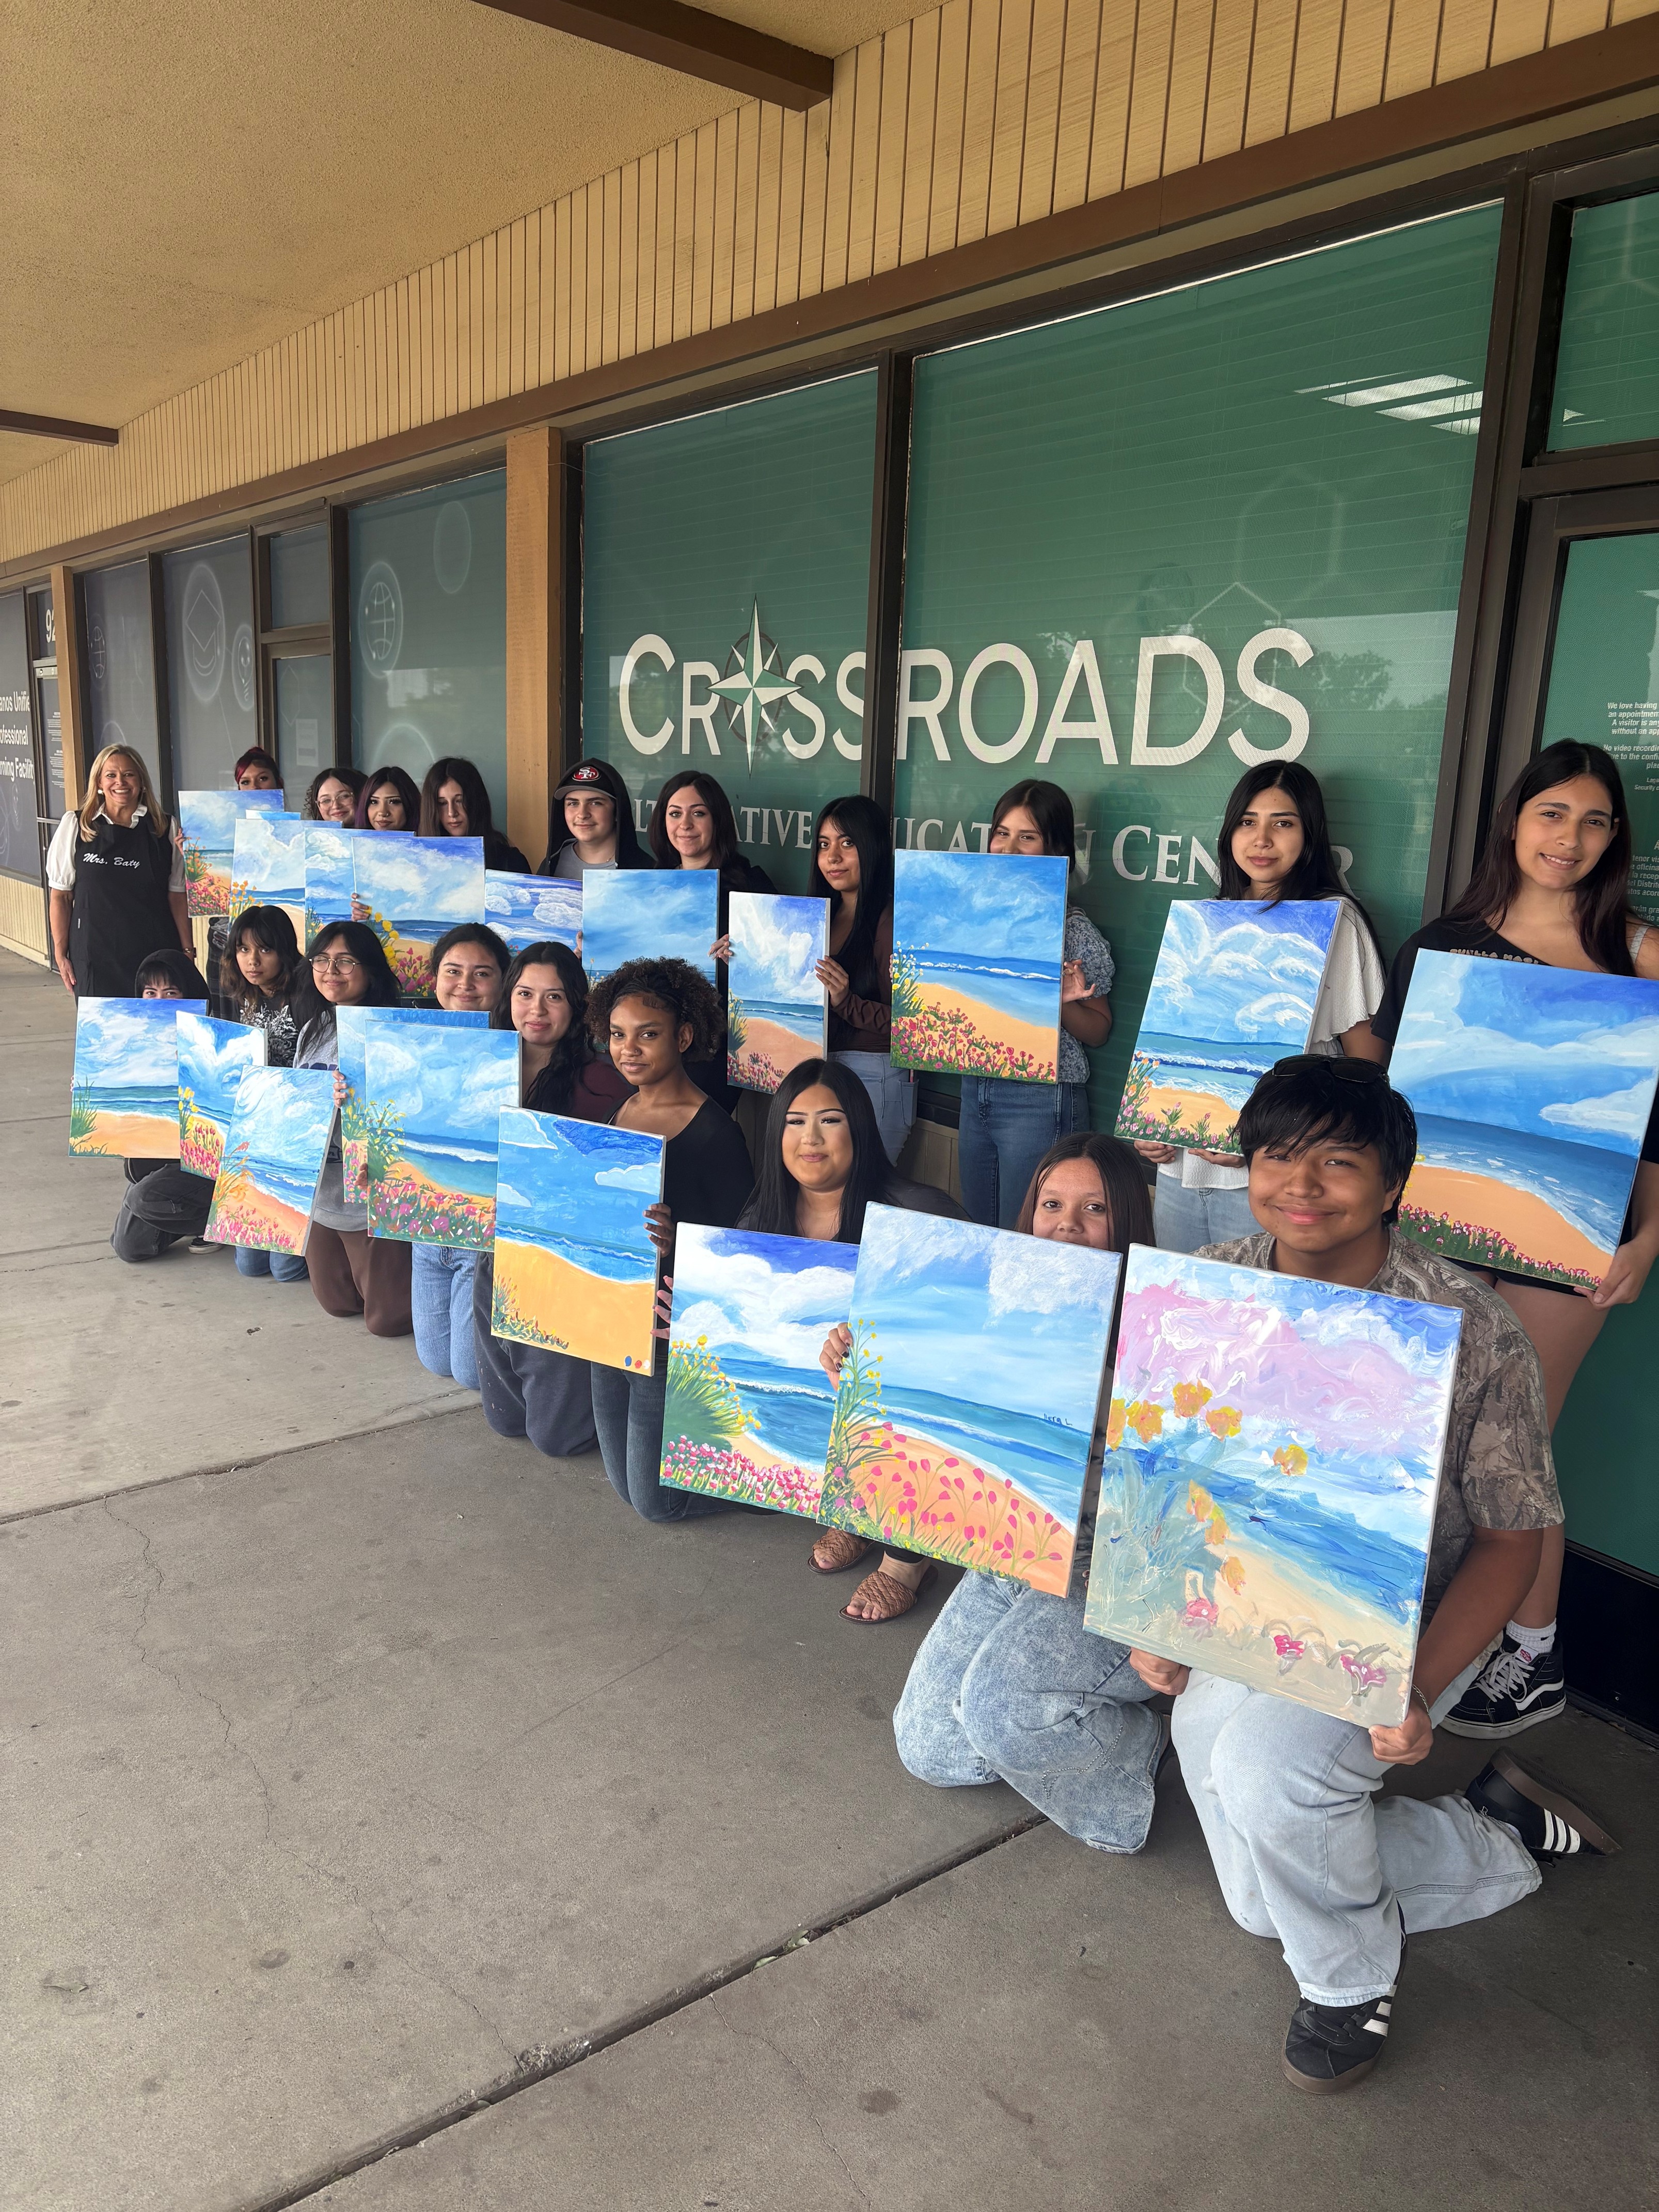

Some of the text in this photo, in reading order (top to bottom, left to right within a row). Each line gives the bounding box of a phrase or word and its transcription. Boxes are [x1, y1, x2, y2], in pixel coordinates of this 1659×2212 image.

[1634, 702, 1657, 710] having
[83, 853, 140, 868] Mrs. Baty
[1112, 825, 1361, 900] CENR
